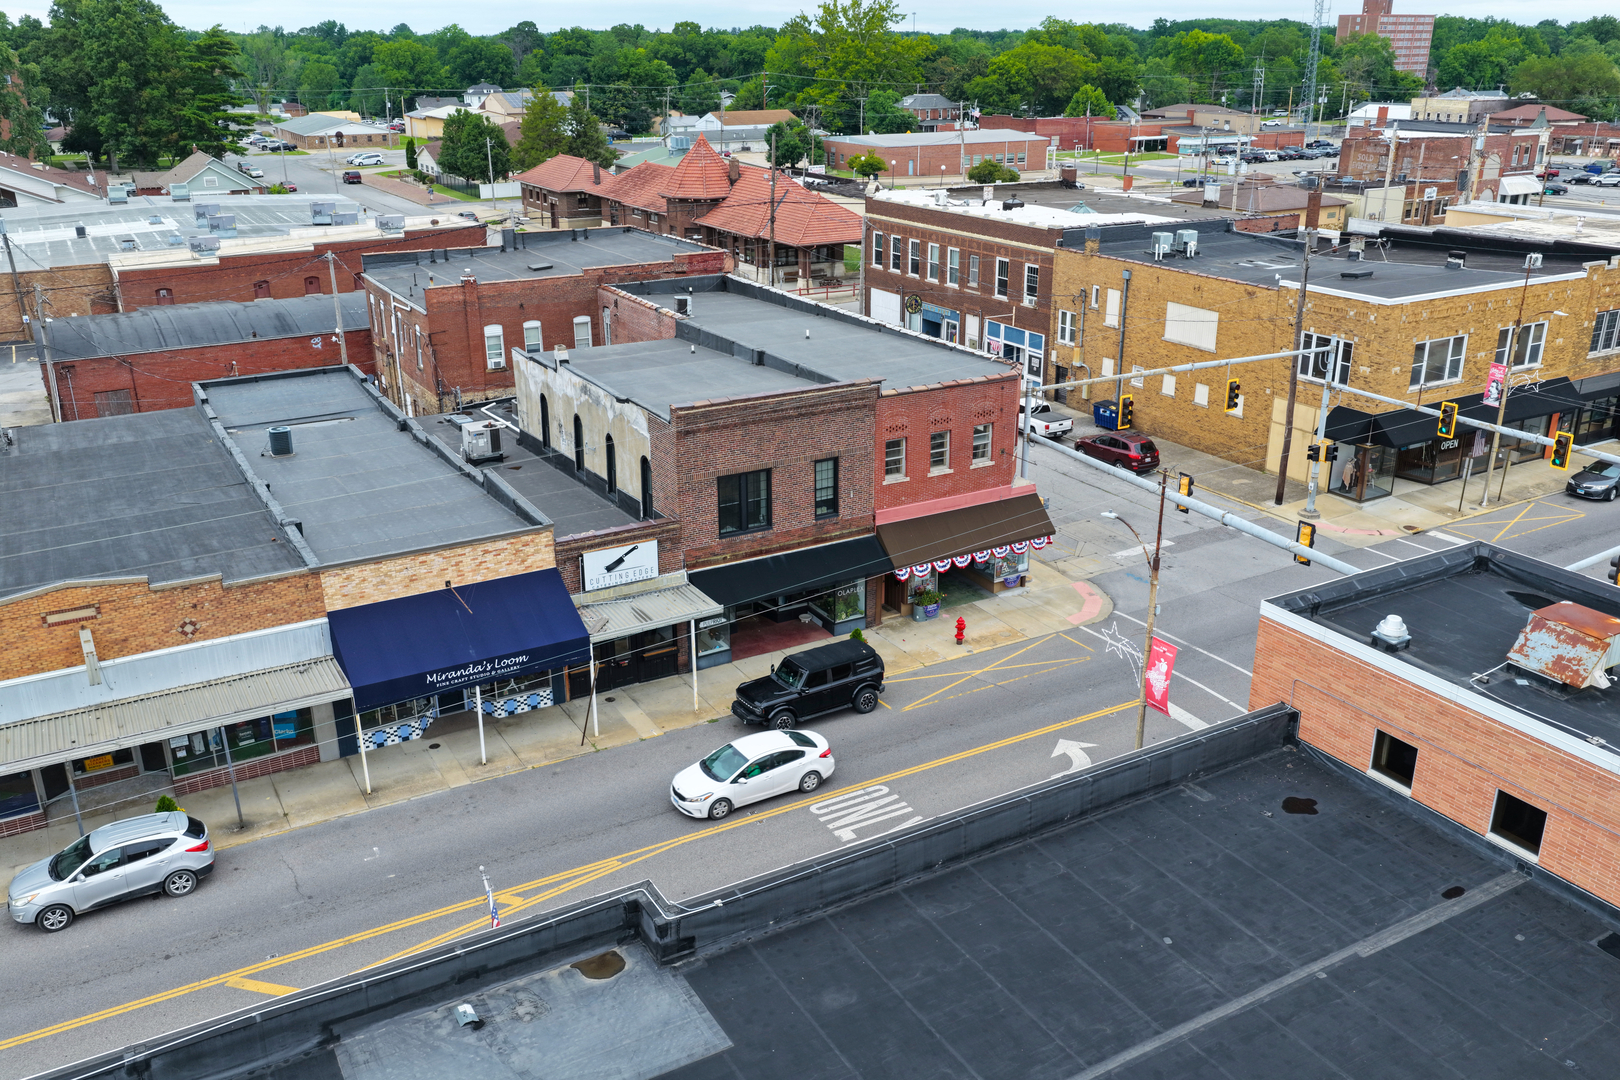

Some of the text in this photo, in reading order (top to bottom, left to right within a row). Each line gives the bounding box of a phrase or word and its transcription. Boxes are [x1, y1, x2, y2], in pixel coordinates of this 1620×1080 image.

[1357, 153, 1374, 161] SOLD
[1440, 439, 1459, 450] OPEN
[589, 566, 654, 586] CUTTING EDGE
[591, 580, 623, 589] CATERING
[837, 585, 864, 597] OLAPLEX
[426, 655, 530, 684] Miranda's Loom
[450, 677, 469, 685] CRAFT
[469, 672, 491, 680] STUDIO
[496, 665, 521, 674] GALLERY
[809, 785, 923, 842] ONL
